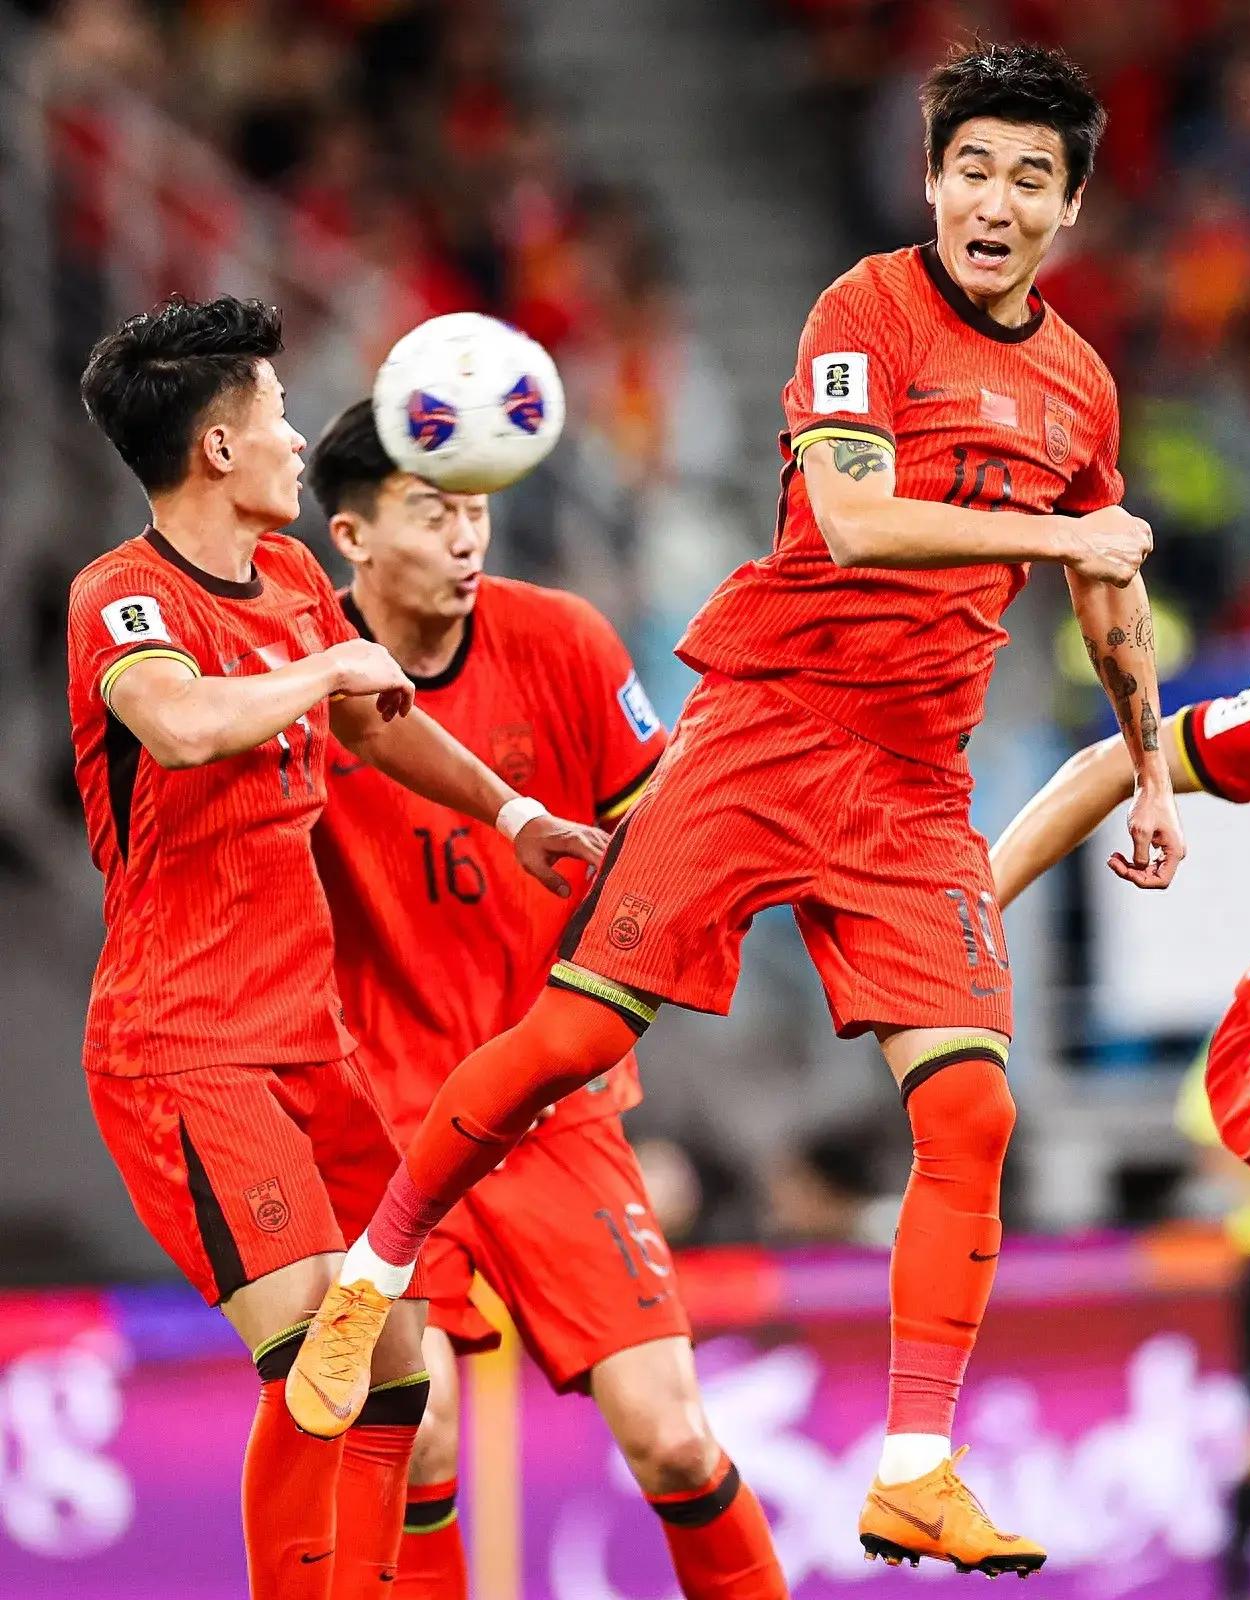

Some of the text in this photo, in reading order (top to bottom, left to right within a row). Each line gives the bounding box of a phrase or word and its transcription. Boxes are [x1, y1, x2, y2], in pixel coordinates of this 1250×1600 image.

[942, 447, 1012, 512] 10
[413, 826, 486, 905] 16
[944, 889, 1010, 970] 10
[593, 1203, 670, 1279] 16
